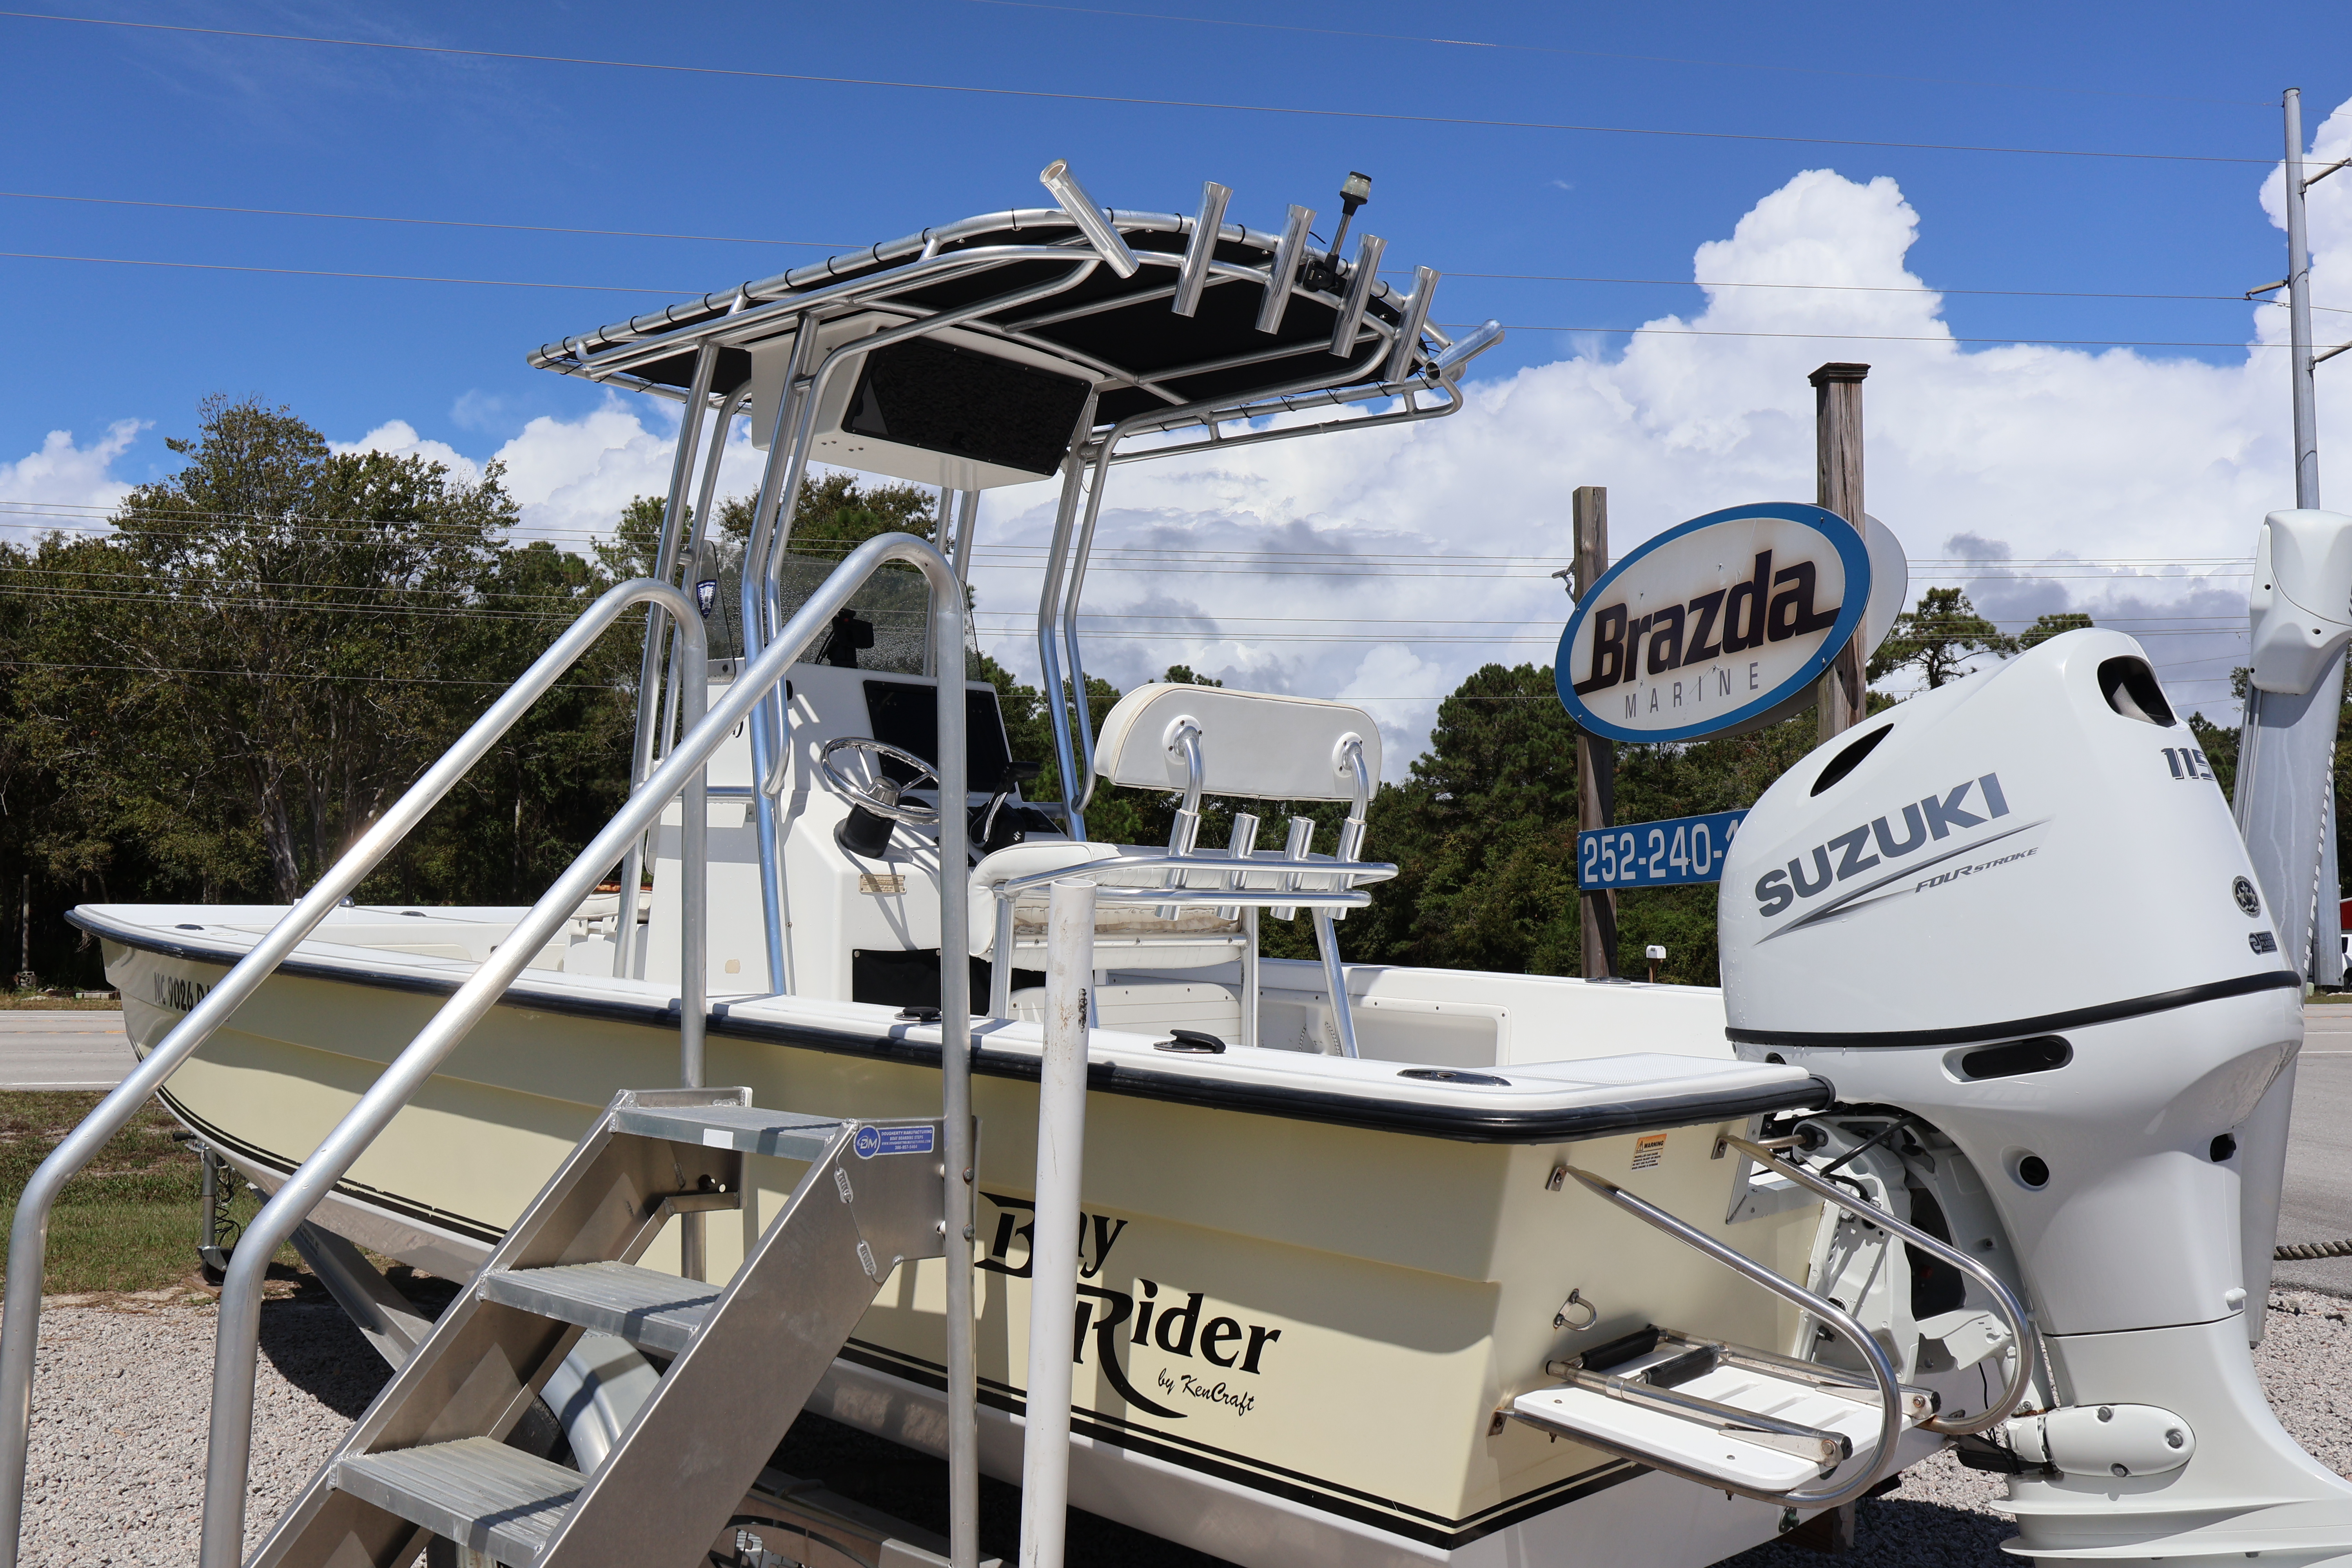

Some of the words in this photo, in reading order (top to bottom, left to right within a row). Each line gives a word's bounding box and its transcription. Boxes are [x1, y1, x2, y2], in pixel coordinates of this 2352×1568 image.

[1573, 549, 1841, 696] Brazda
[1625, 661, 1759, 719] MARINE
[2161, 748, 2216, 781] 115
[1755, 772, 2010, 917] SUZUKI
[154, 972, 166, 1005] NC
[168, 976, 194, 1012] 9026
[1644, 1140, 1664, 1149] WARNING
[1073, 1278, 1281, 1418] Rider
[1158, 1367, 1175, 1396] by
[1181, 1374, 1255, 1417] KenCraft
